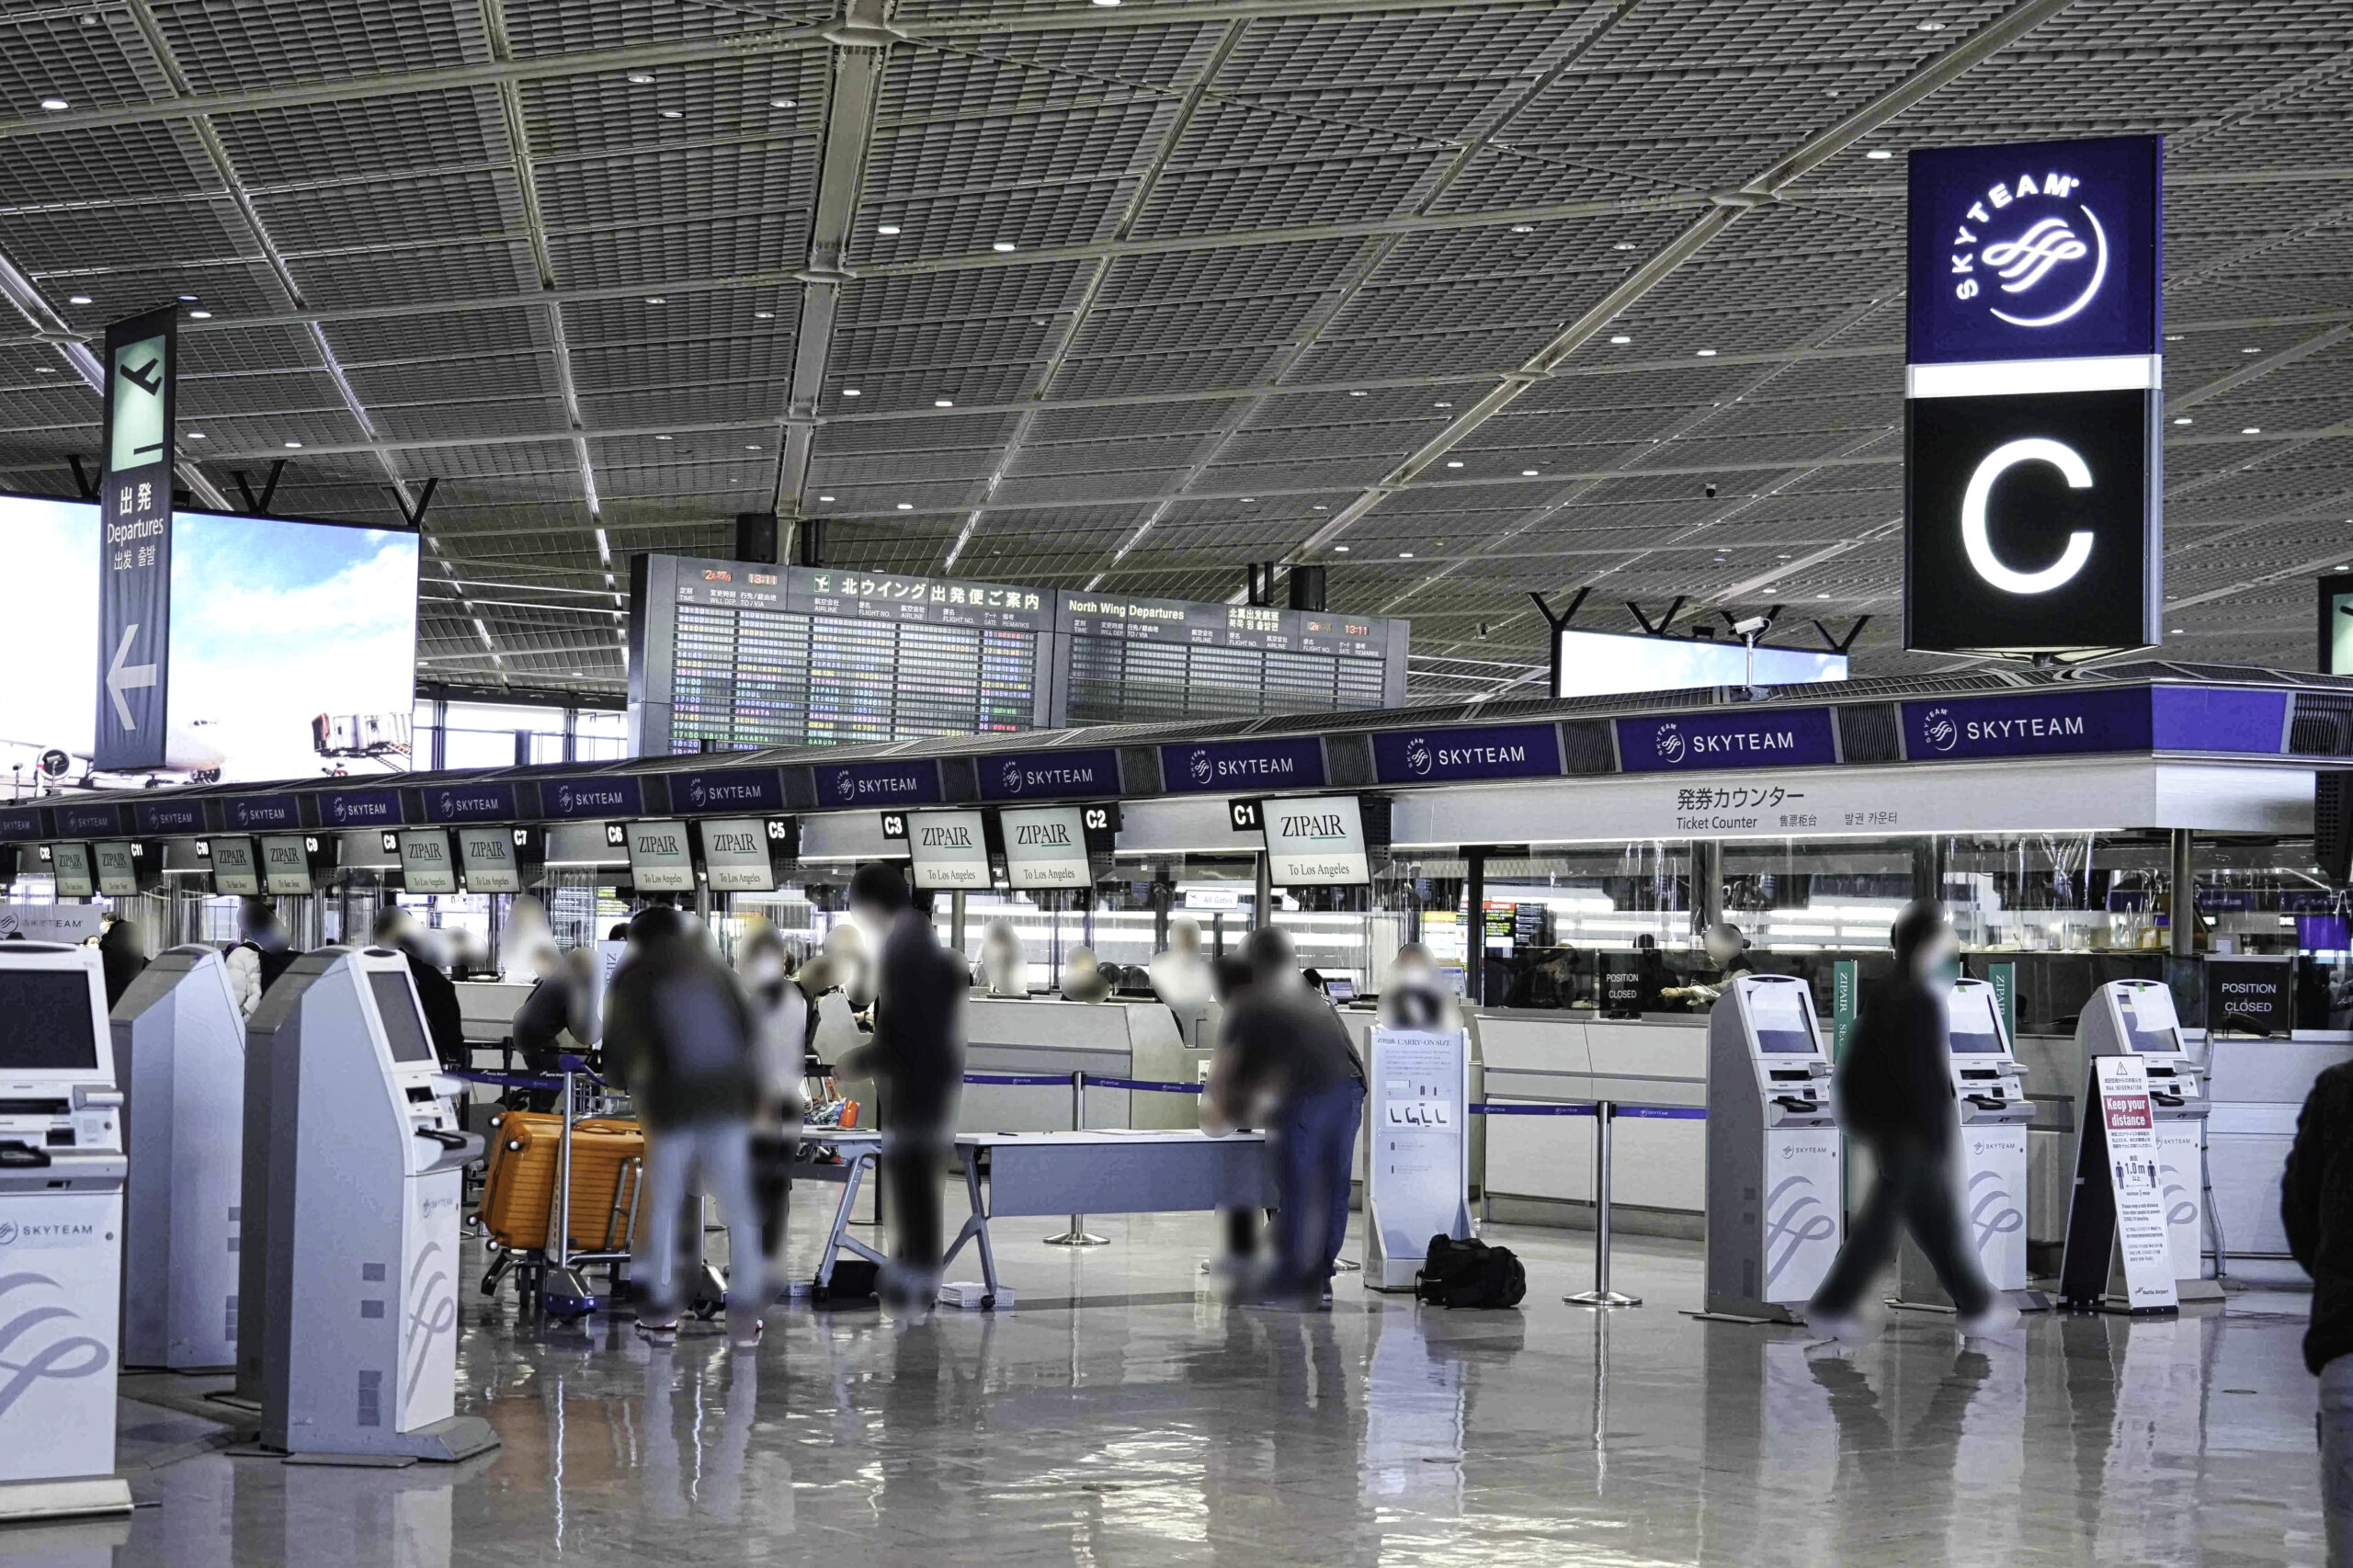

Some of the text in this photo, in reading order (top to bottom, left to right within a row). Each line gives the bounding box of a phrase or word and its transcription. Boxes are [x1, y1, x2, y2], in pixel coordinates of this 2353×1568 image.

[1951, 173, 2072, 301] SKYTEAM
[119, 482, 152, 516] 出発
[1961, 437, 2094, 595] C
[107, 517, 165, 547] Departures
[114, 550, 133, 571] 出发
[138, 544, 156, 567] 출발
[749, 574, 778, 585] 13:11
[841, 577, 1040, 610] 北ウイング出発便ご案内
[1069, 600, 1185, 620] North Wing Departures
[858, 608, 880, 617] FLIGHT
[943, 616, 964, 624] FLIGHT
[1003, 620, 1029, 629] REMARKS
[1346, 624, 1370, 636] 13:11
[811, 687, 840, 695] ZIPAIR
[1923, 708, 1949, 744] SKYTEAM
[1967, 717, 2085, 740] SKYTEAM
[733, 734, 769, 743] JAKARTA
[1693, 732, 1794, 753] SKYTEAM
[1438, 746, 1526, 766] SKYTEAM
[1218, 758, 1294, 776] SKYTEAM
[1027, 768, 1094, 785] SKYTEAM
[858, 778, 917, 793] SKYTEAM
[576, 792, 623, 806] SKYTEAM
[710, 786, 762, 801] SKYTEAM
[1677, 786, 1805, 812] 発券カウンター
[348, 803, 387, 816] SKYTEAM
[456, 799, 498, 812] SKYTEAM
[78, 816, 109, 828] SKYTEAM
[160, 812, 193, 825] SKYTEAM
[250, 808, 286, 821] SKYTEAM
[1086, 810, 1108, 829] C2
[1233, 805, 1256, 825] C1
[1779, 814, 1818, 827] 售票柜台
[1845, 811, 1898, 825] 발권 카운터
[768, 822, 786, 839] C5
[884, 816, 904, 835] C3
[1281, 814, 1347, 837] ZIPAIR
[1677, 816, 1758, 830] Ticket Counter
[514, 830, 528, 846] C7
[608, 825, 623, 843] C6
[922, 826, 973, 846] ZIPAIR
[1017, 824, 1071, 846] ZIPAIR
[196, 841, 210, 856] C10
[306, 837, 319, 852] C9
[383, 835, 397, 849] C8
[471, 841, 506, 858] ZIPAIR
[638, 835, 679, 854] ZIPAIR
[713, 833, 757, 852] ZIPAIR
[40, 846, 51, 860] C12
[131, 843, 143, 858] C11
[219, 849, 247, 864] ZIPAIR
[270, 848, 301, 863] ZIPAIR
[409, 843, 442, 859] ZIPAIR
[59, 854, 82, 869] ZIPAIR
[102, 853, 127, 867] ZIPAIR
[927, 869, 976, 883] To Los Angeles
[1023, 869, 1075, 882] To Los Angeles
[1288, 863, 1350, 878] To Los Angeles
[414, 878, 446, 889] To Los Angeles
[476, 877, 510, 889] To Los Angeles
[644, 874, 683, 887] To Los Angeles
[719, 873, 761, 886] To Los Angeles
[1214, 896, 1233, 904] Gates
[1607, 973, 1640, 983] POSITION
[1608, 990, 1637, 1000] CLOSED
[1839, 971, 1848, 1013] ZIPAIR
[2222, 983, 2277, 994] POSITION
[2224, 1003, 2272, 1012] CLOSED
[2107, 1098, 2146, 1113] Keep your
[2112, 1114, 2146, 1127] distance
[1795, 1146, 1827, 1154] SKYTEAM
[1985, 1142, 2016, 1151] SKYTEAM
[2125, 1163, 2146, 1175] 1.0m
[23, 1224, 93, 1236] SKYTEAM
